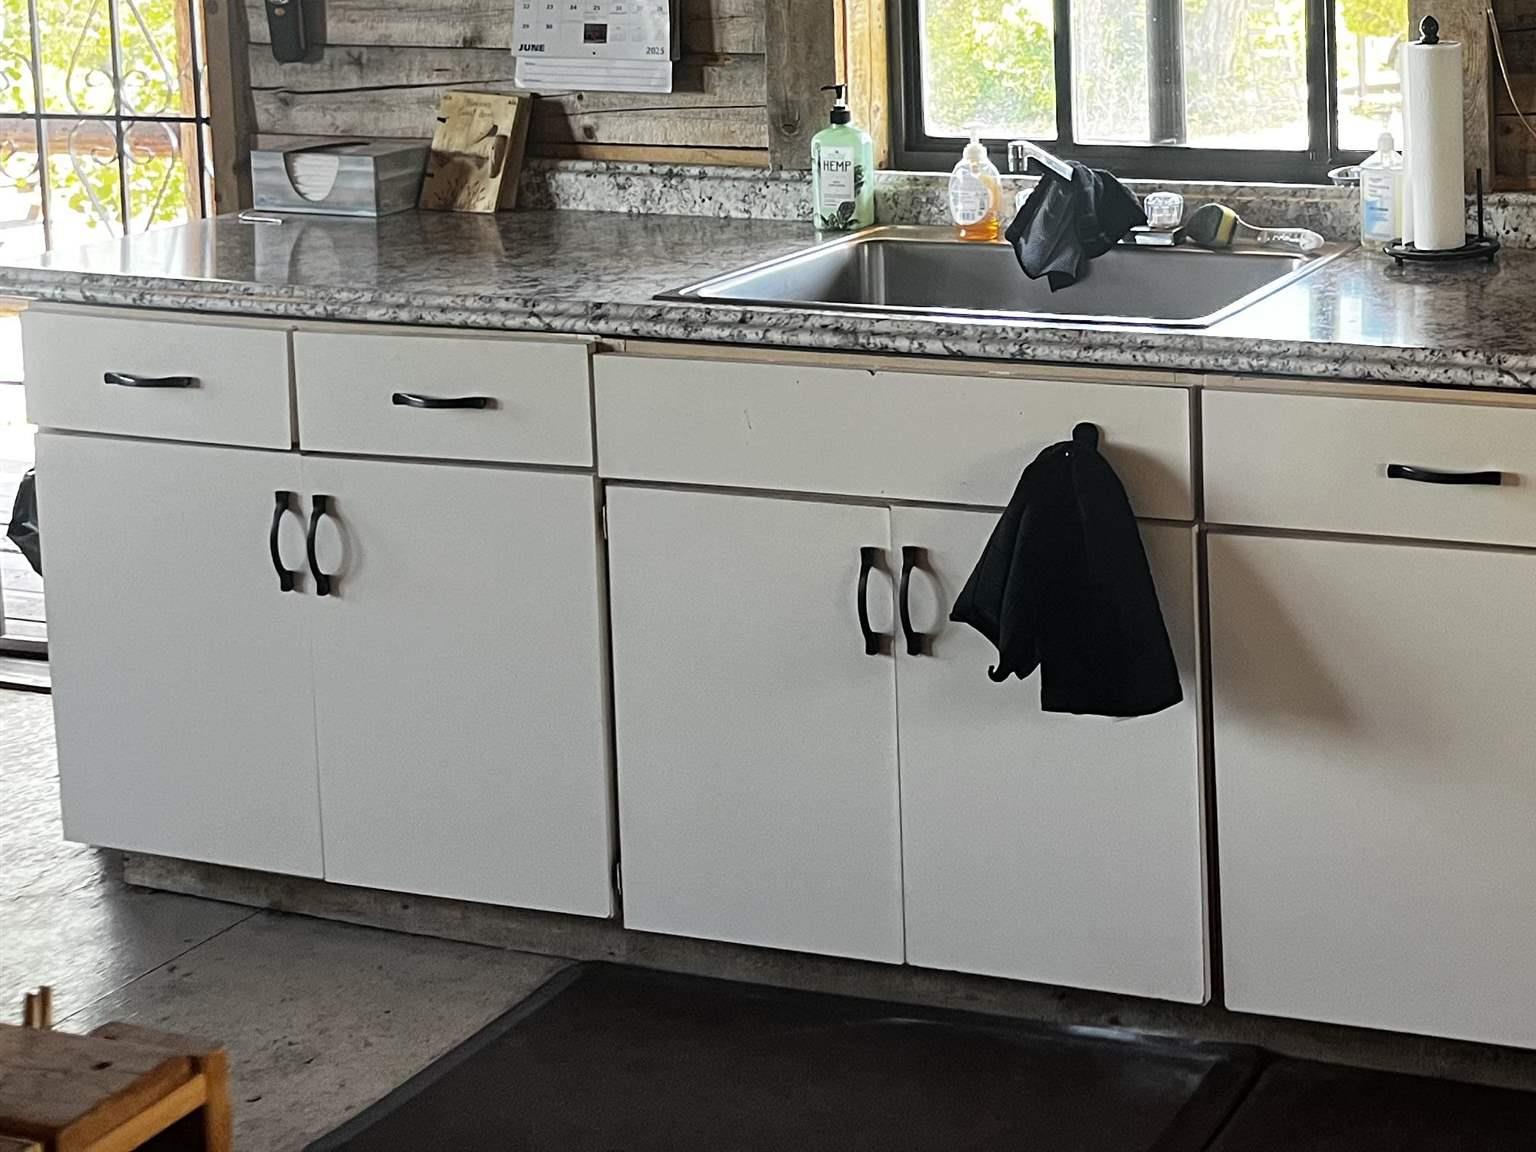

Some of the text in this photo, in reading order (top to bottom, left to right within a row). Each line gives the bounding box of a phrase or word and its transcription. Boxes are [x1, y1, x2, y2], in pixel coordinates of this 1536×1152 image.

[518, 43, 665, 55] JUNE 2025
[823, 160, 852, 173] HEMP
